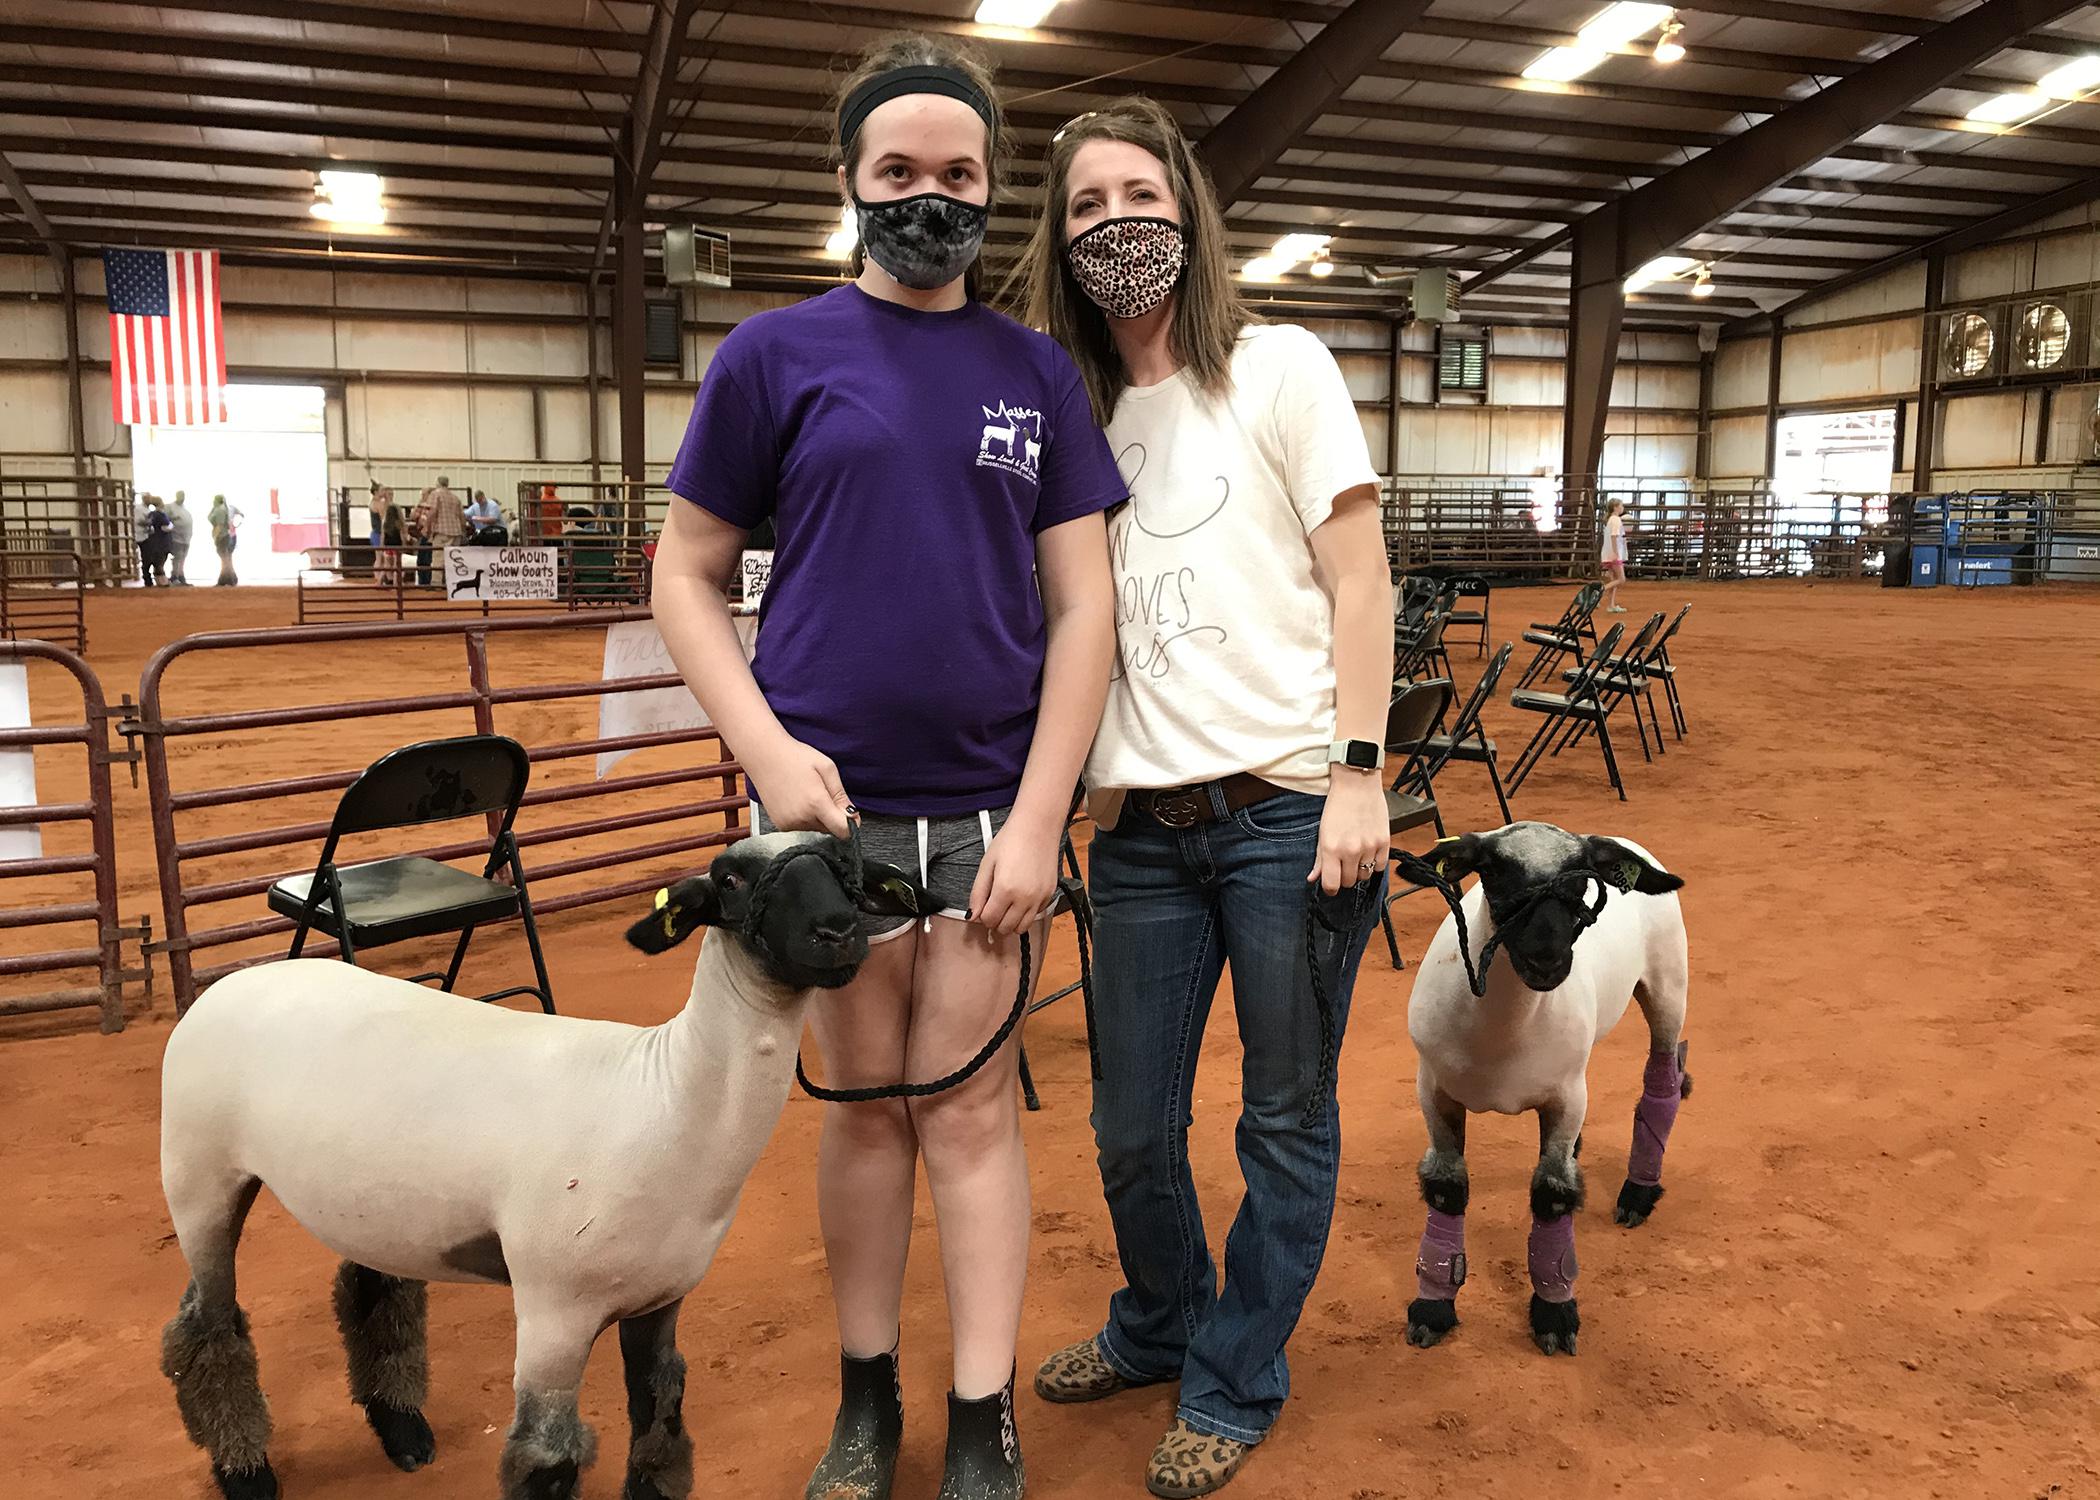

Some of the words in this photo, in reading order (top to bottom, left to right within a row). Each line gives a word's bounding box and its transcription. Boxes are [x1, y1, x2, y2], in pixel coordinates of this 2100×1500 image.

[982, 398, 1043, 438] Massey
[499, 548, 549, 564] Calhoun
[488, 563, 519, 578] Show
[522, 564, 554, 578] Goats
[489, 578, 521, 589] Blooming
[1610, 863, 1632, 894] 9085
